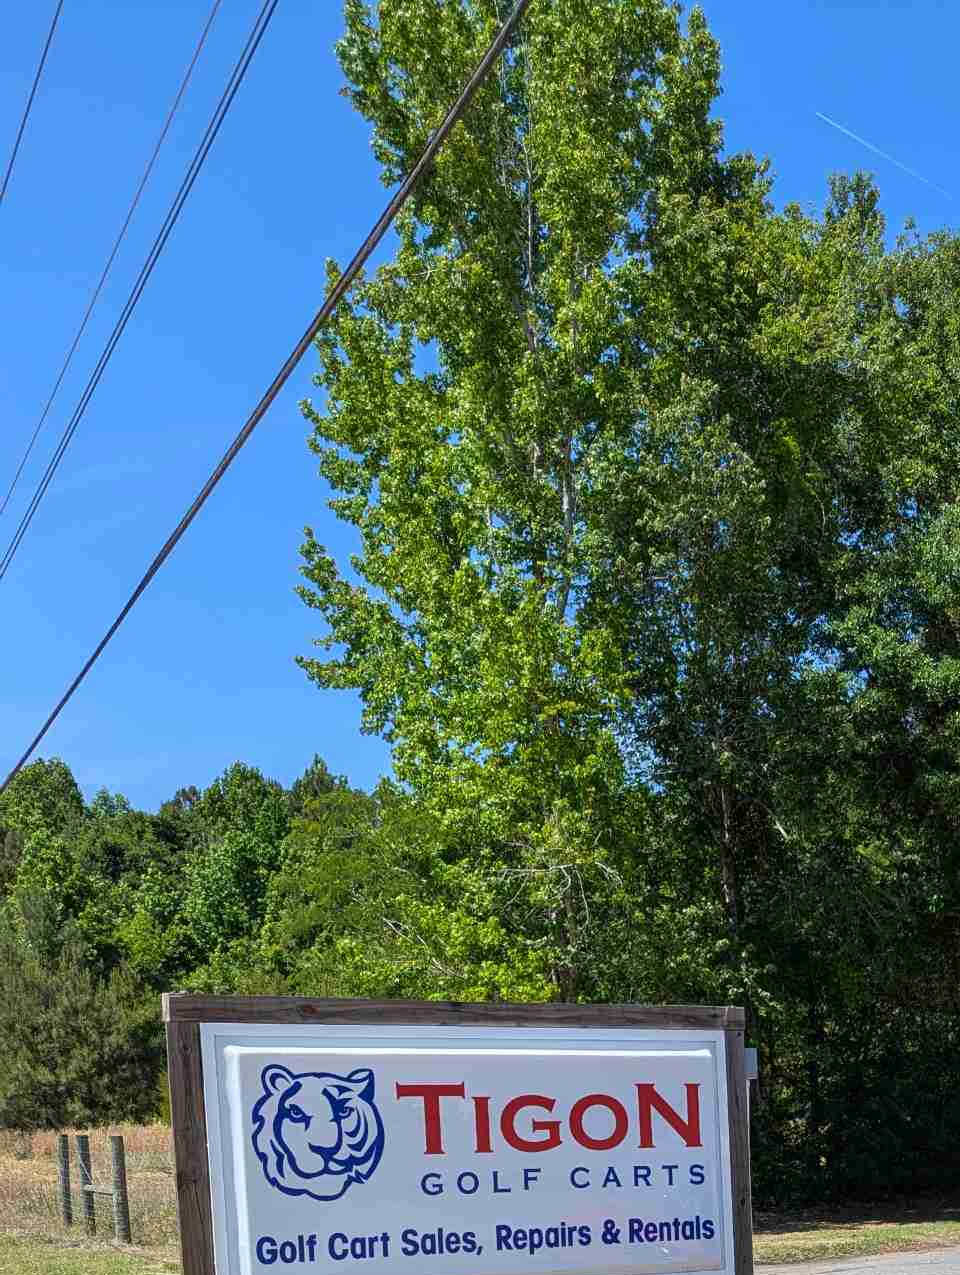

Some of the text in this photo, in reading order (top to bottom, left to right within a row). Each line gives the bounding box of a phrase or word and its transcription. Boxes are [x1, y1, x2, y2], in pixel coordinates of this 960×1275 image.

[396, 1081, 704, 1155] TIGON
[421, 1163, 705, 1196] GOLF CARTS
[255, 1215, 715, 1265] Golf Cart Sales, Repairs & Rentals
